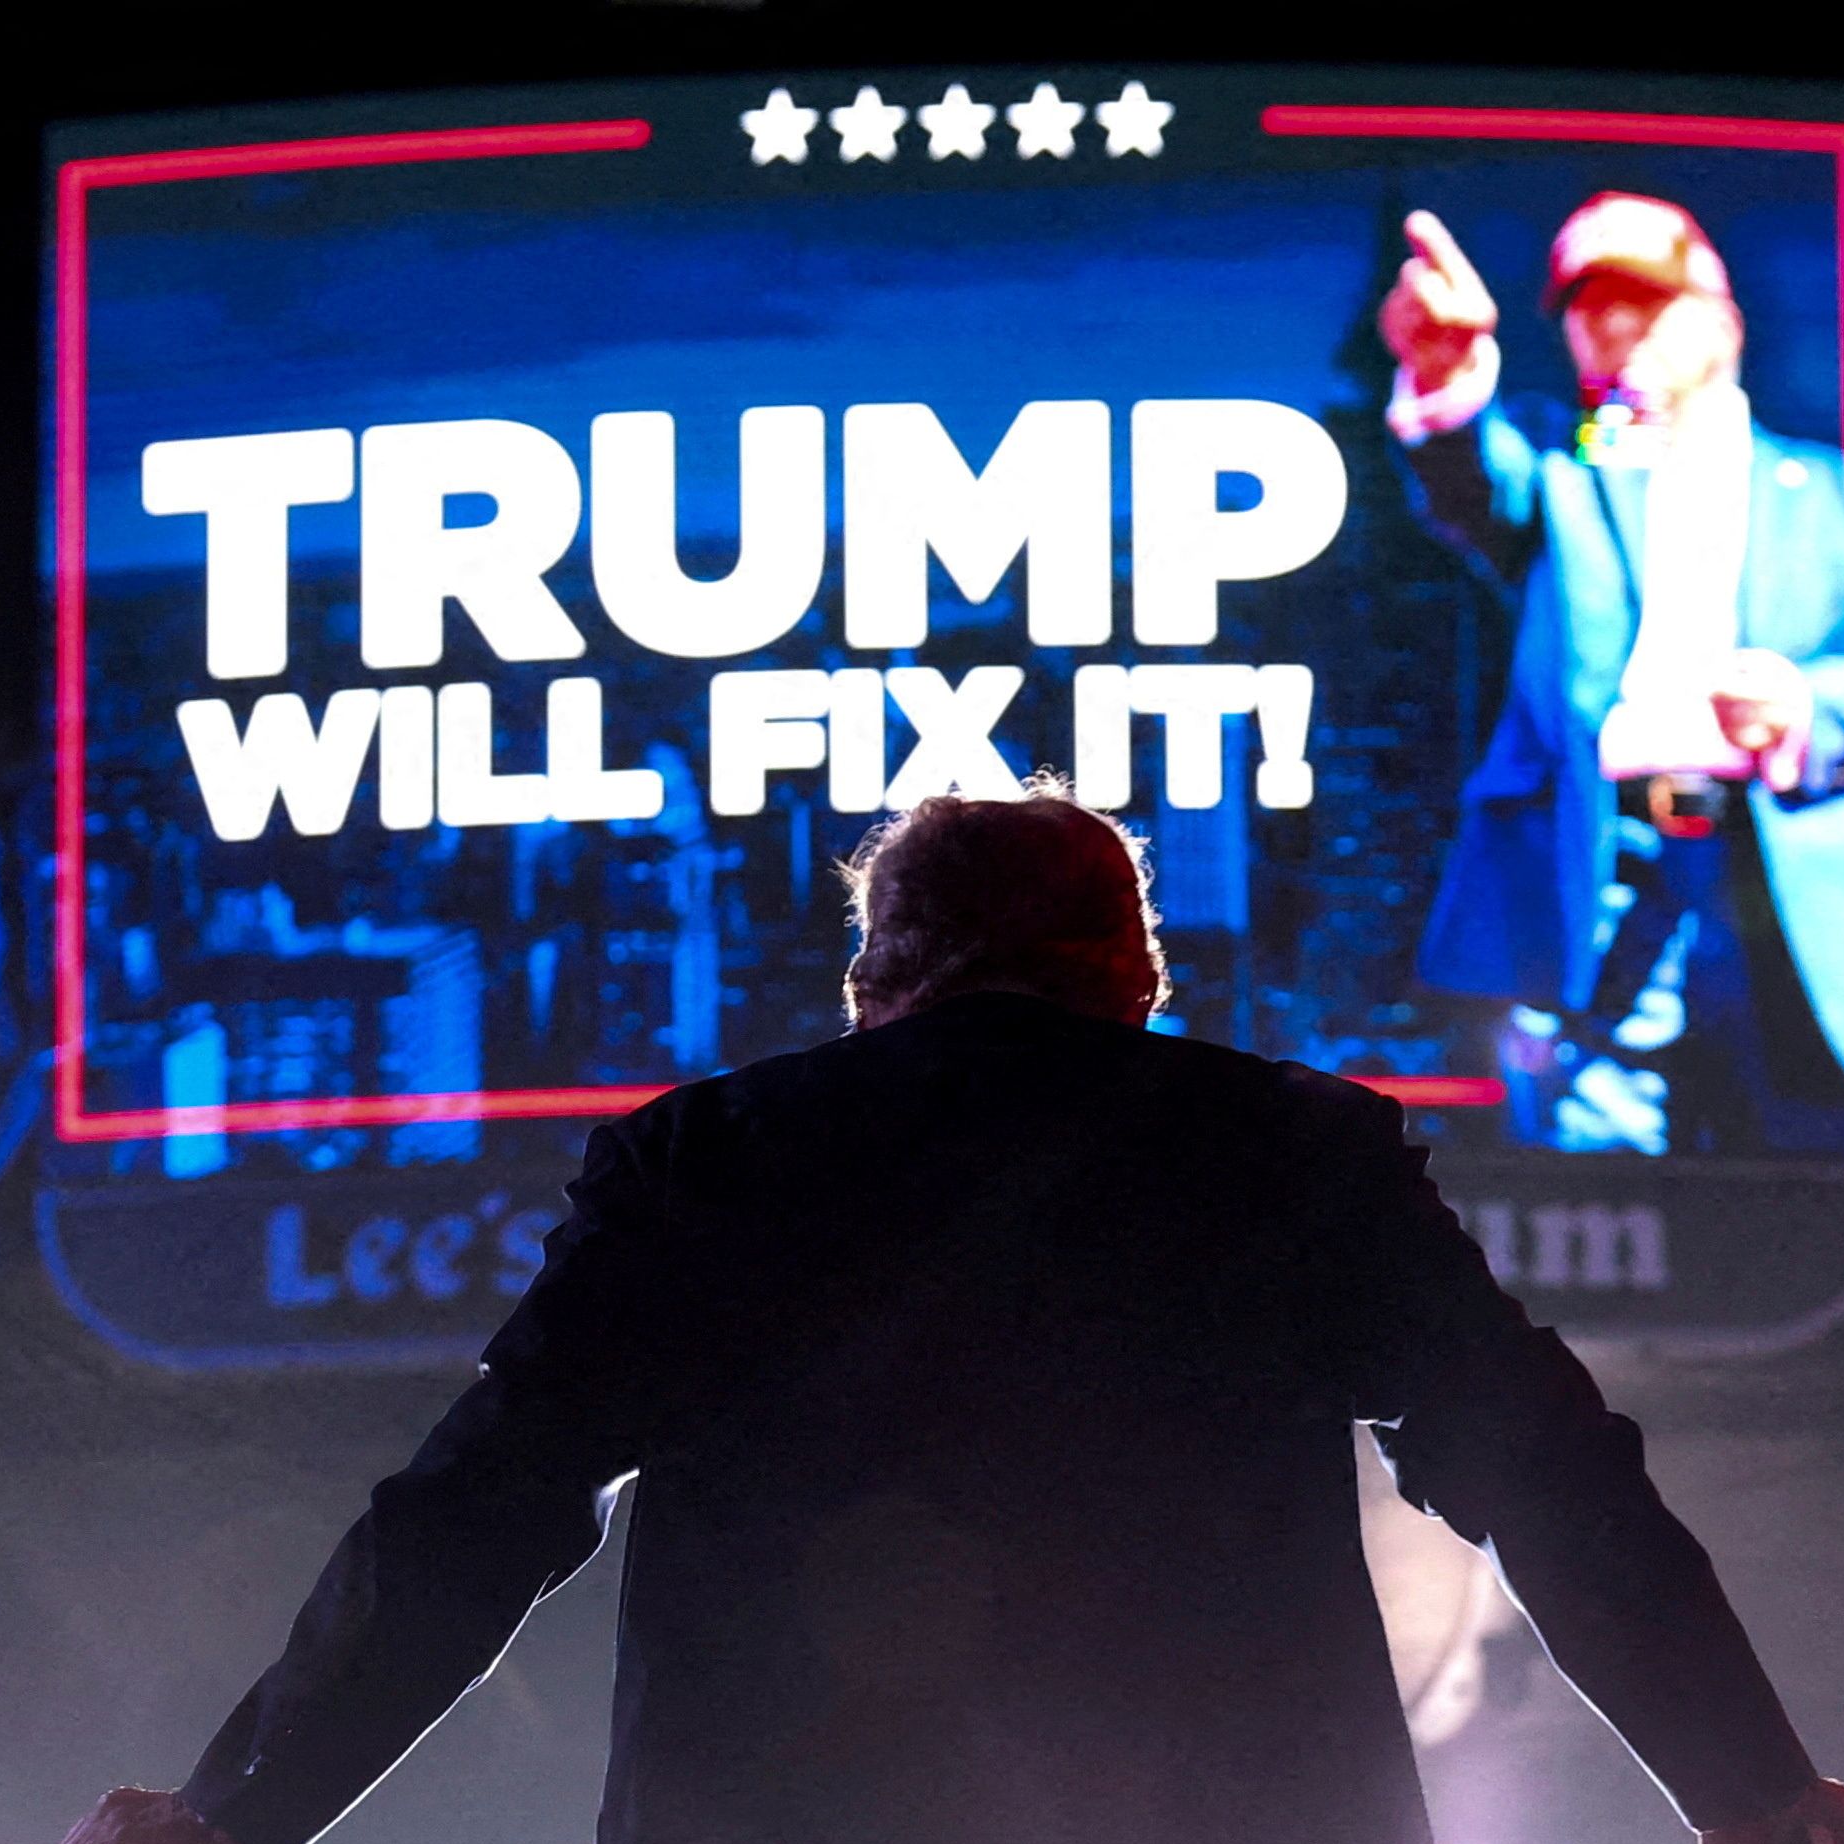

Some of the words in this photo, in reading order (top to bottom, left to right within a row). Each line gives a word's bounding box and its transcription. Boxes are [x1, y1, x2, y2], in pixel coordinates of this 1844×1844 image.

[141, 399, 1348, 680] TRUMP
[175, 676, 665, 842] WILL
[709, 665, 1025, 816] FIX
[1074, 663, 1314, 810] IT!
[264, 1190, 556, 1308] Lee's
